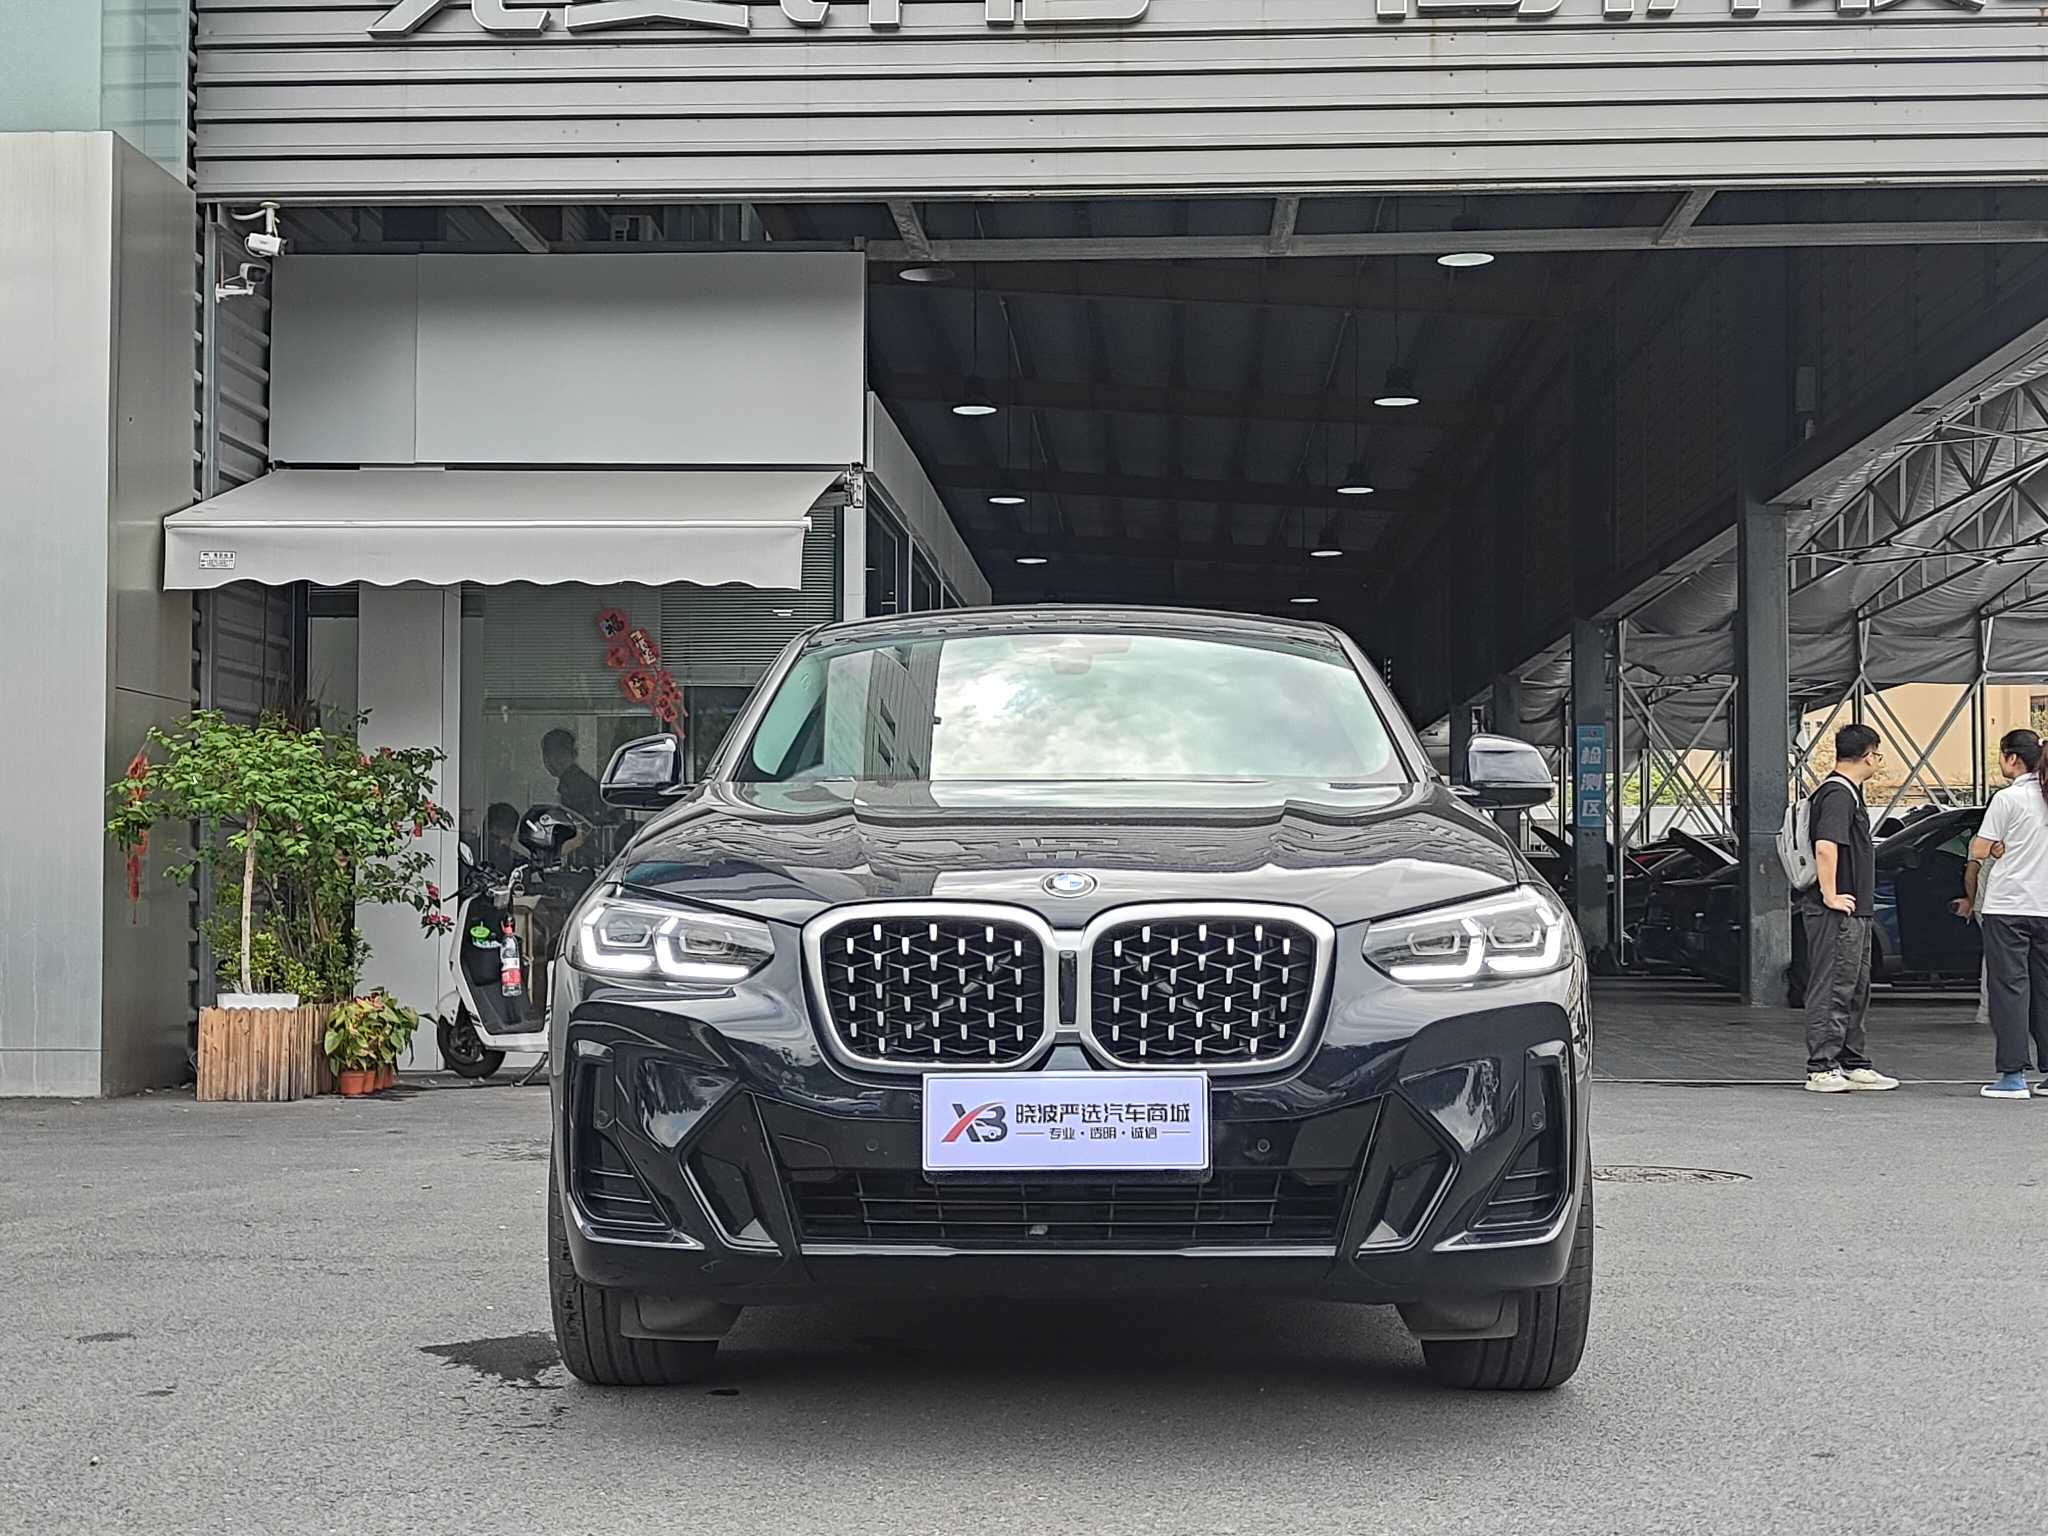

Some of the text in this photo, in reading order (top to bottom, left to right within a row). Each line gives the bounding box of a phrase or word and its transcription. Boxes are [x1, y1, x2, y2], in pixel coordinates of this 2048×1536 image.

[1015, 1103, 1191, 1124] 晓波严选汽车商城
